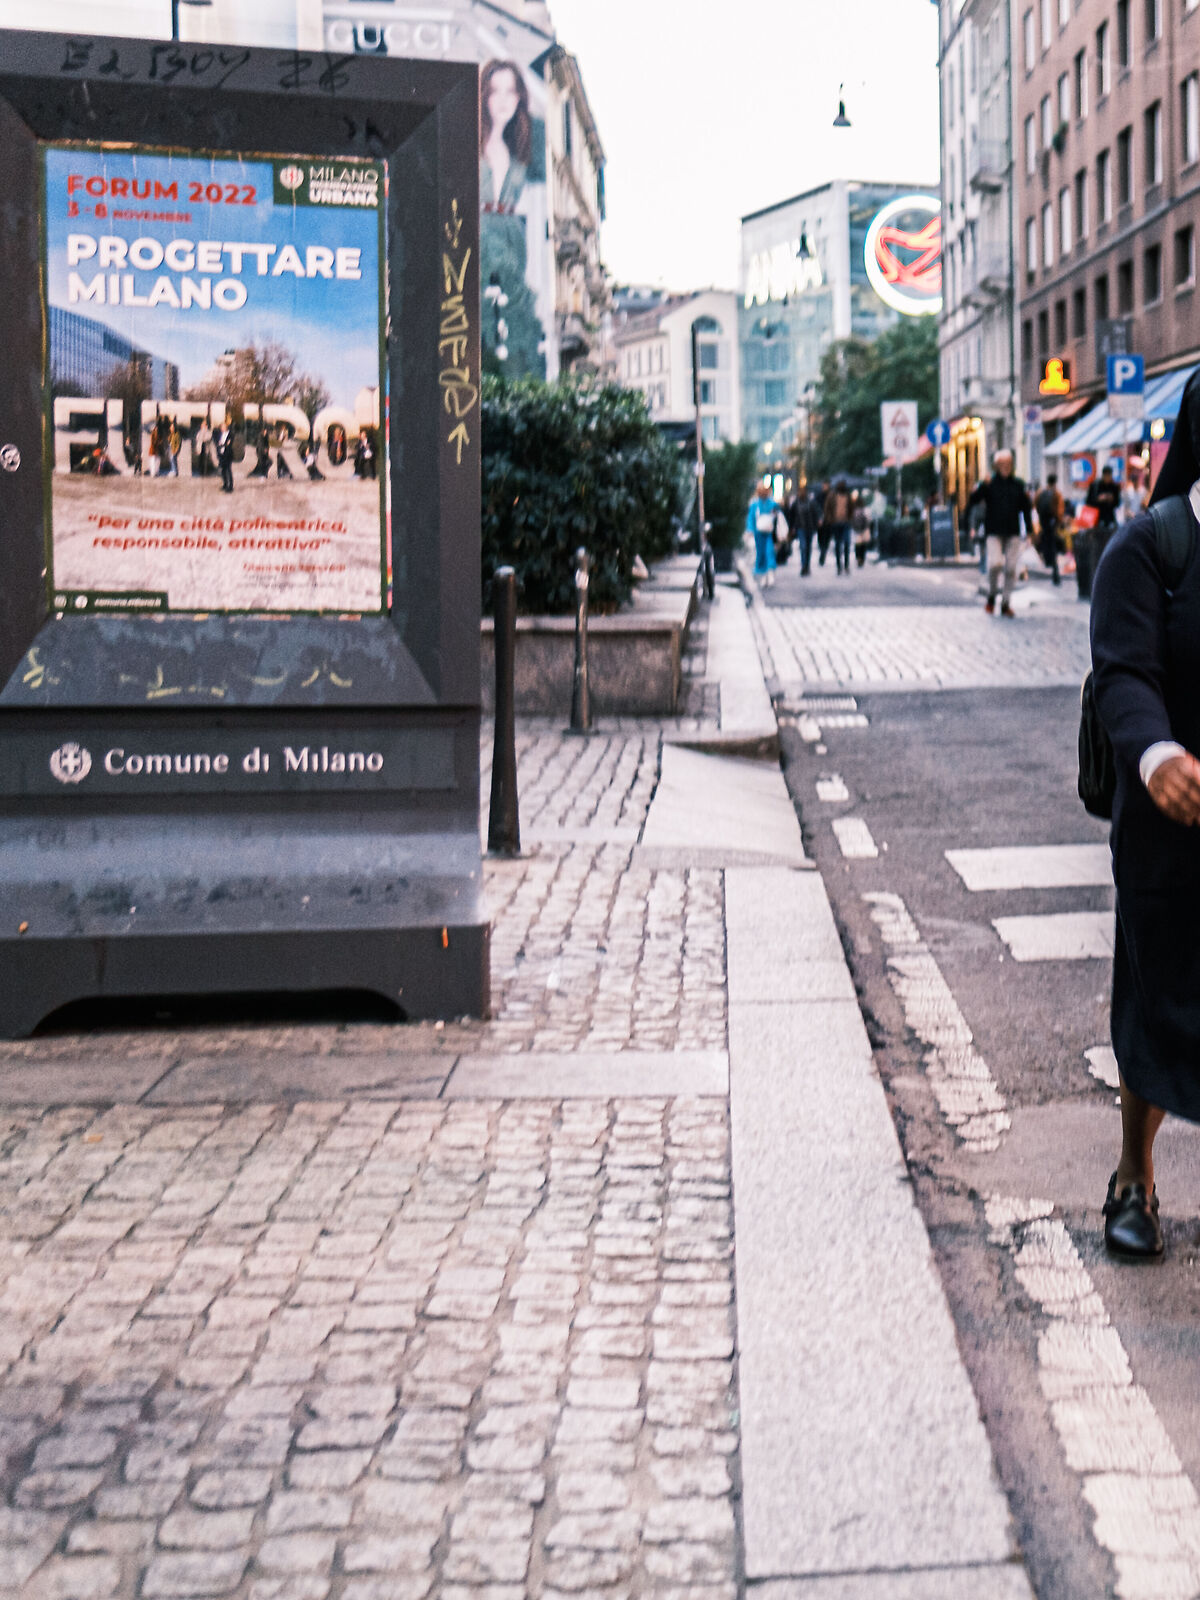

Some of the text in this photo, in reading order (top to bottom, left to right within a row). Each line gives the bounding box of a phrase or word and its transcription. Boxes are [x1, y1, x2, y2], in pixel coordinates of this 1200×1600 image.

[327, 20, 450, 51] GUCCI
[309, 166, 379, 183] MILANO
[67, 175, 257, 206] FORUM 2022
[67, 234, 362, 280] PROGETTARE
[68, 272, 248, 311] MILANO
[1114, 359, 1136, 389] P
[138, 518, 175, 531] una
[93, 536, 222, 551] responsabile,
[104, 746, 384, 775] Comune di Milano
